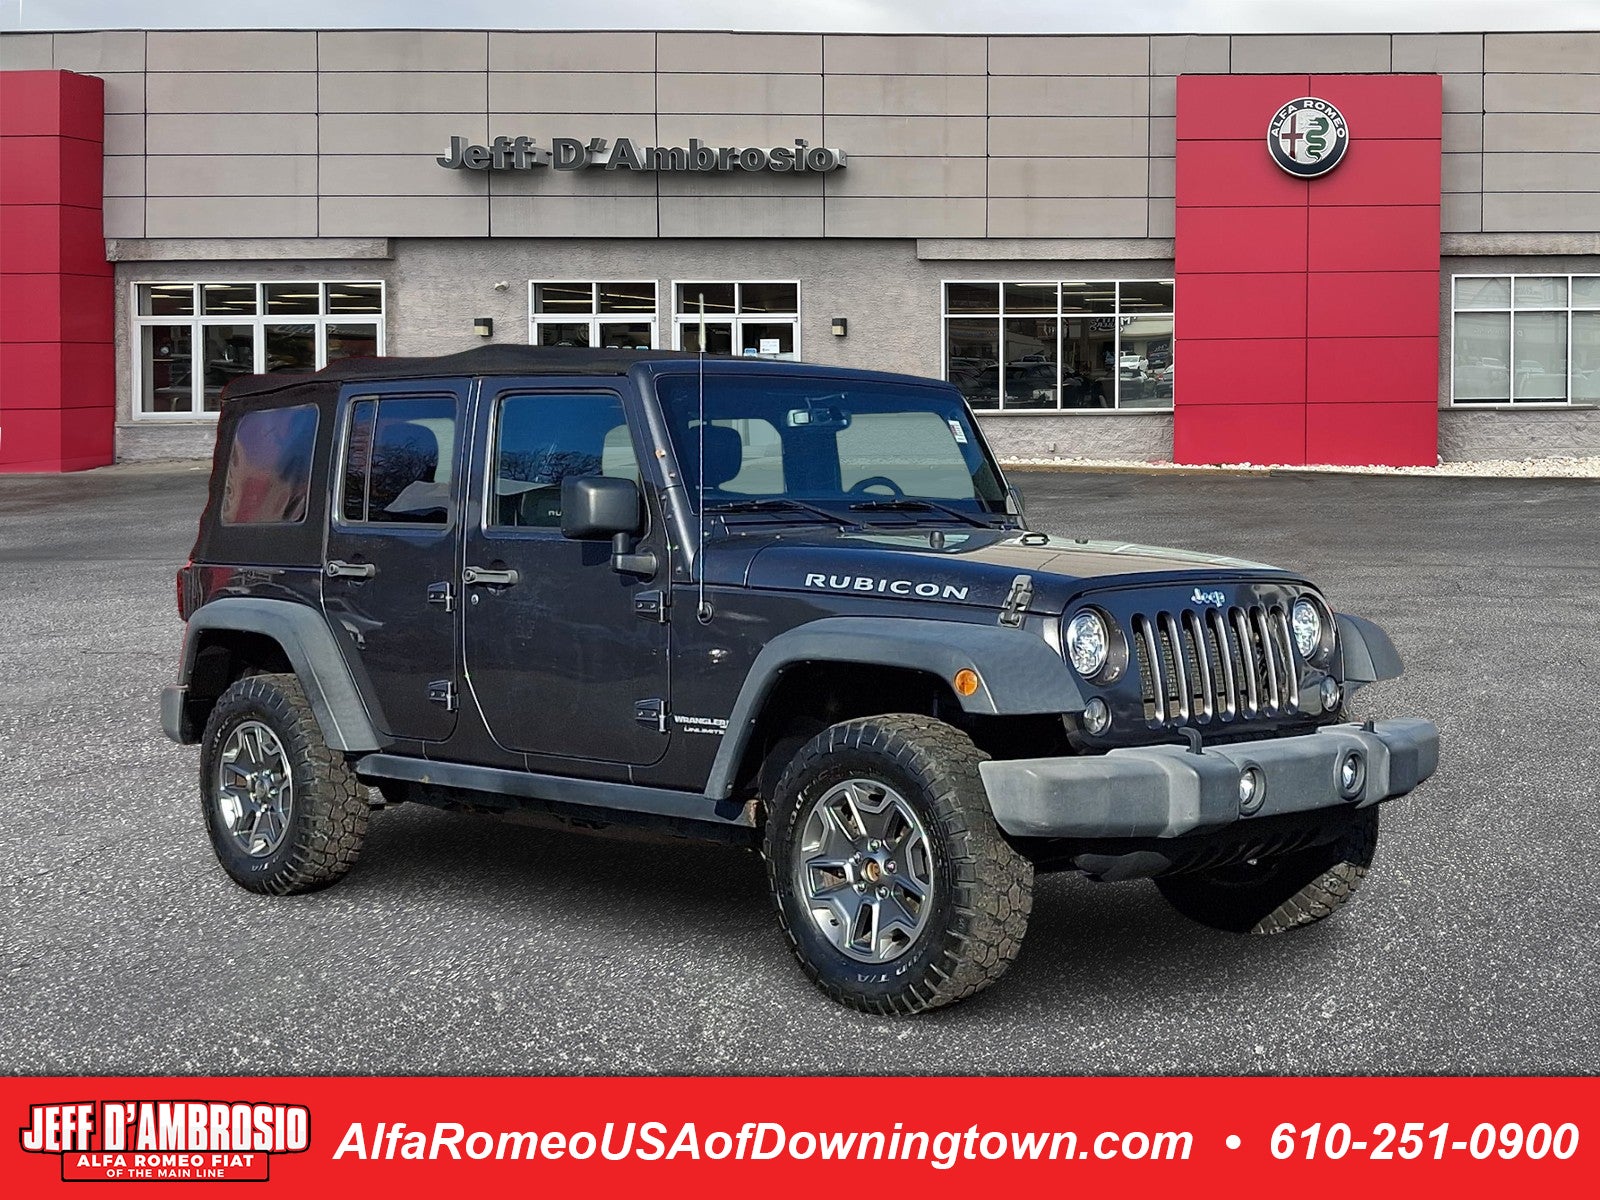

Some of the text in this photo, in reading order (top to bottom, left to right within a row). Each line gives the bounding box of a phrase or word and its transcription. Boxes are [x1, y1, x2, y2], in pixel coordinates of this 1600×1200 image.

[1271, 100, 1346, 138] ALFA ROMEO
[436, 135, 845, 172] Jeff D'Ambrosio
[804, 573, 969, 600] RUBICON
[1190, 587, 1226, 608] Jeep
[683, 725, 725, 735] UNLIMITE
